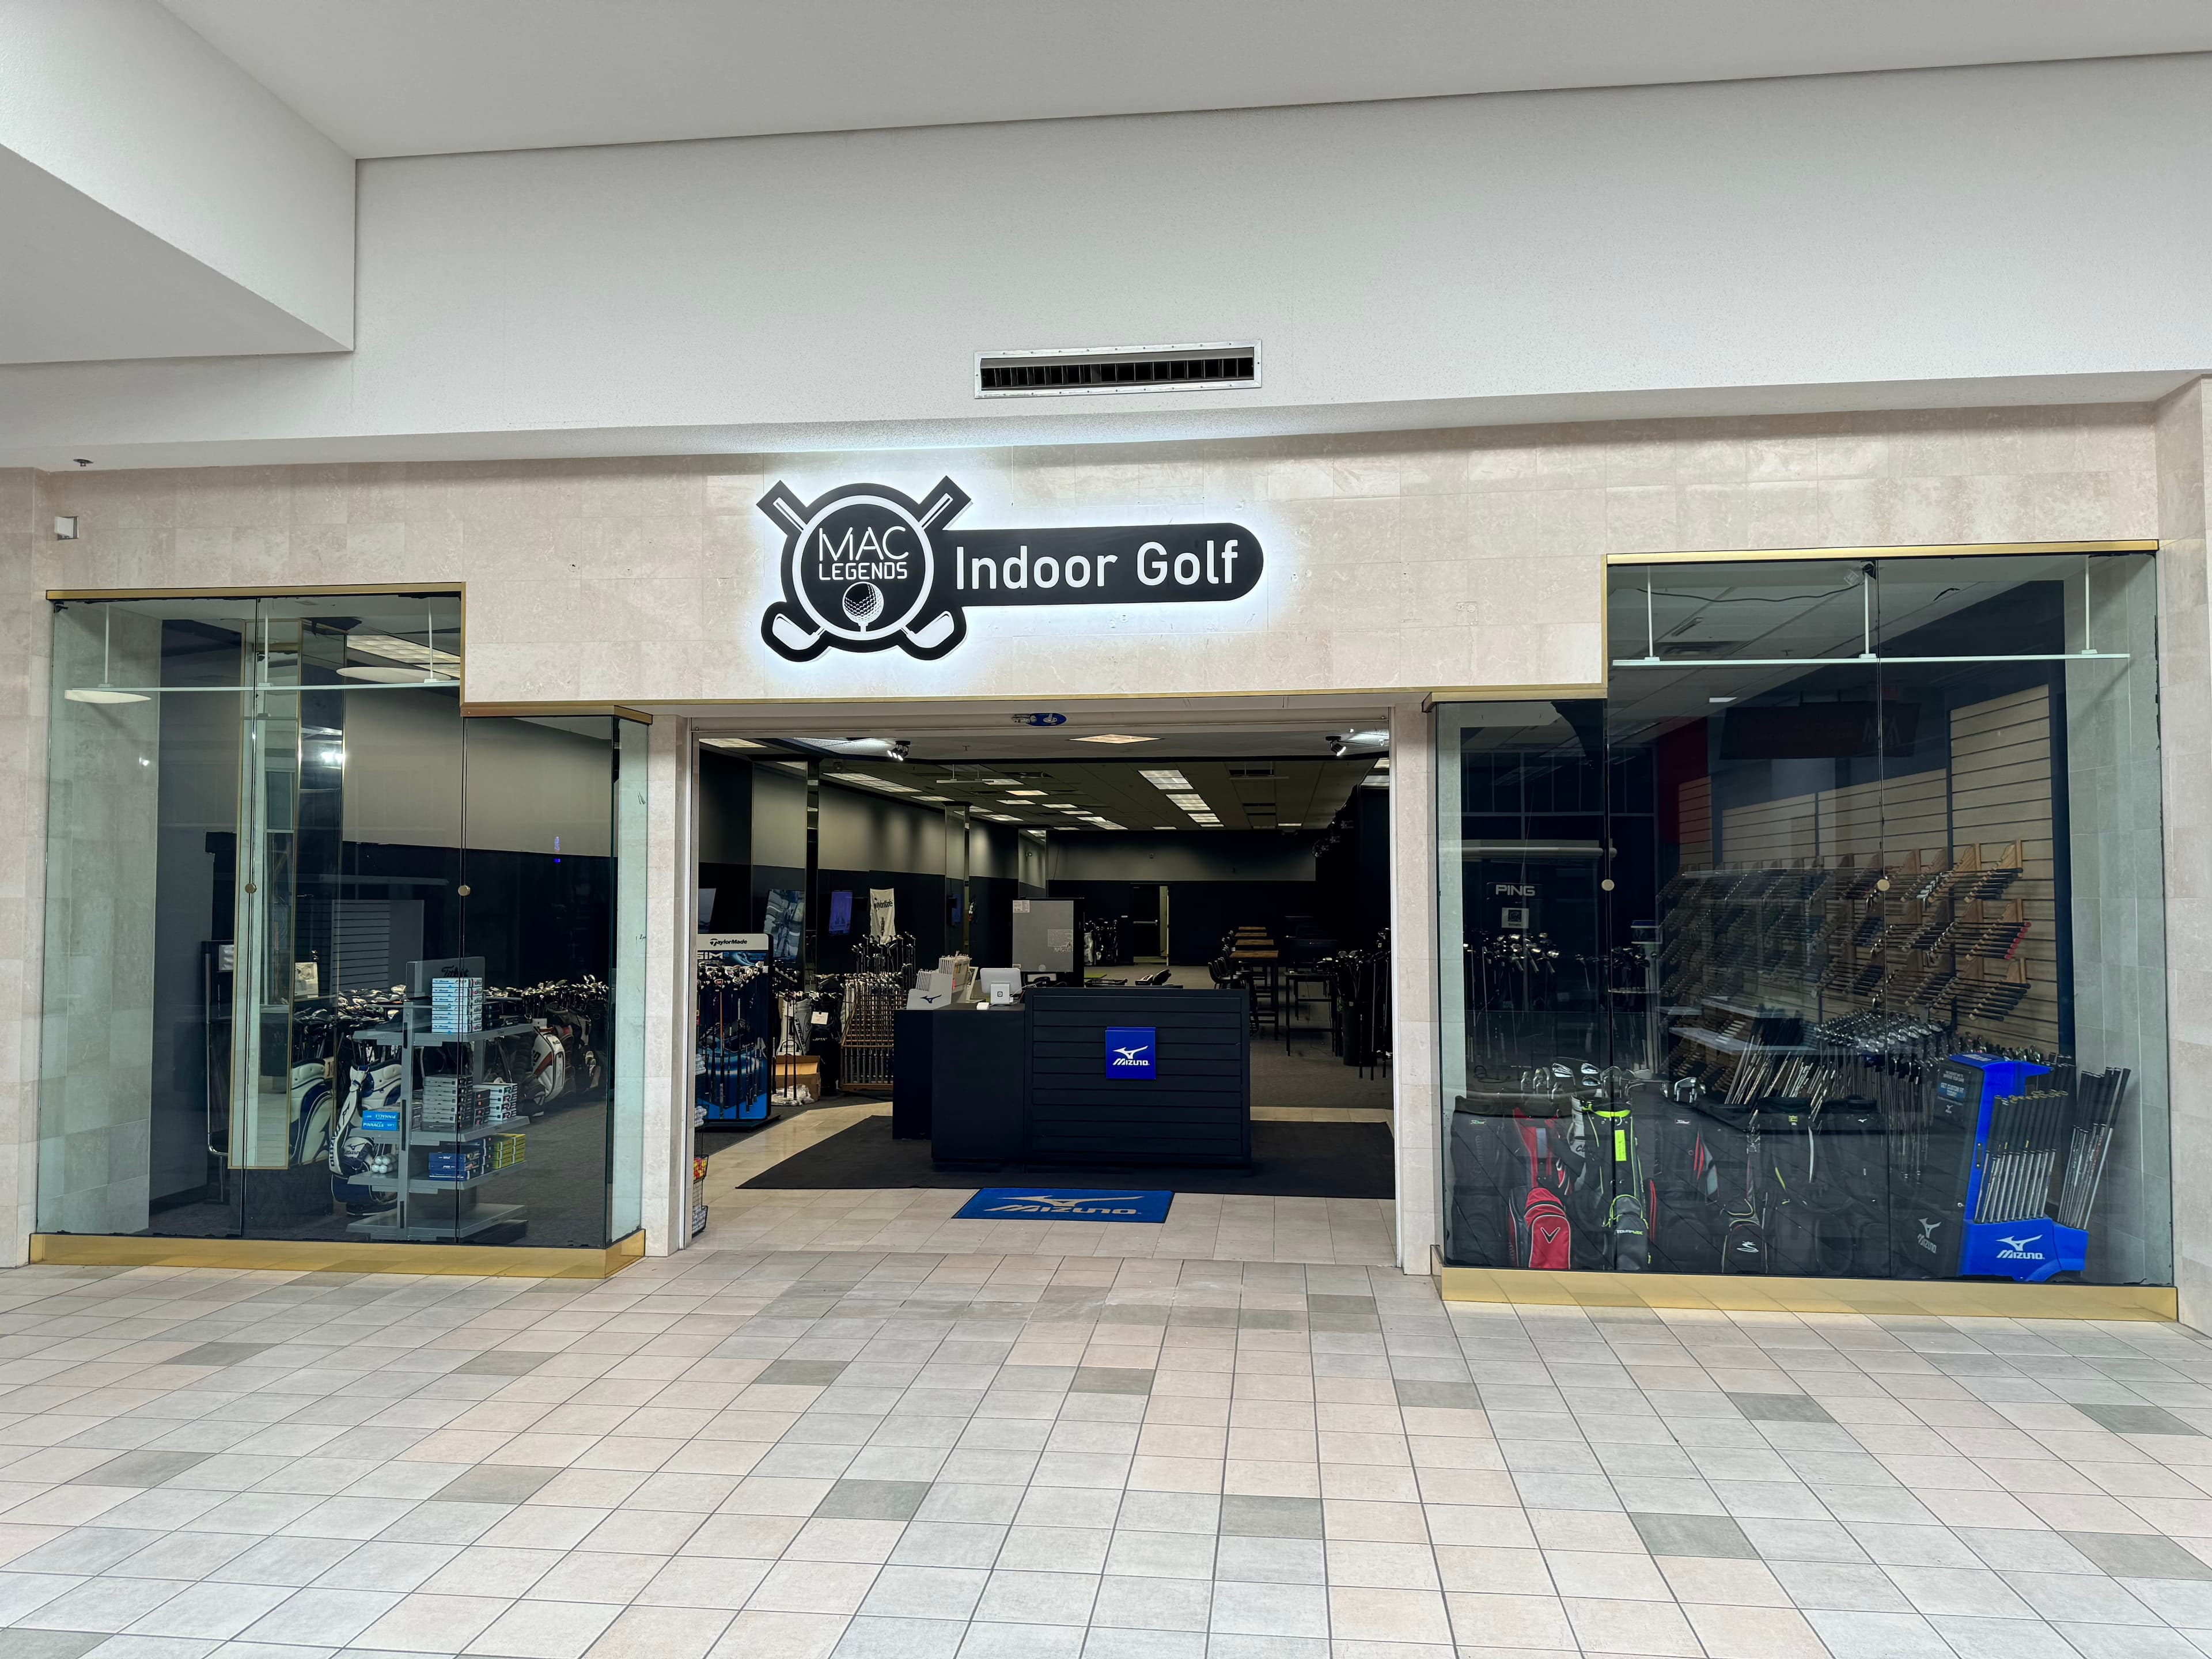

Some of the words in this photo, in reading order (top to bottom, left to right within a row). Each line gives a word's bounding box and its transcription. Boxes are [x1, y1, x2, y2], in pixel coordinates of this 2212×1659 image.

[819, 525, 909, 562] MAC
[819, 562, 908, 581] LEGENDS
[956, 546, 1118, 590] Indoor
[1137, 539, 1238, 586] Golf
[1495, 884, 1536, 896] PING
[709, 938, 748, 946] TaylorMade
